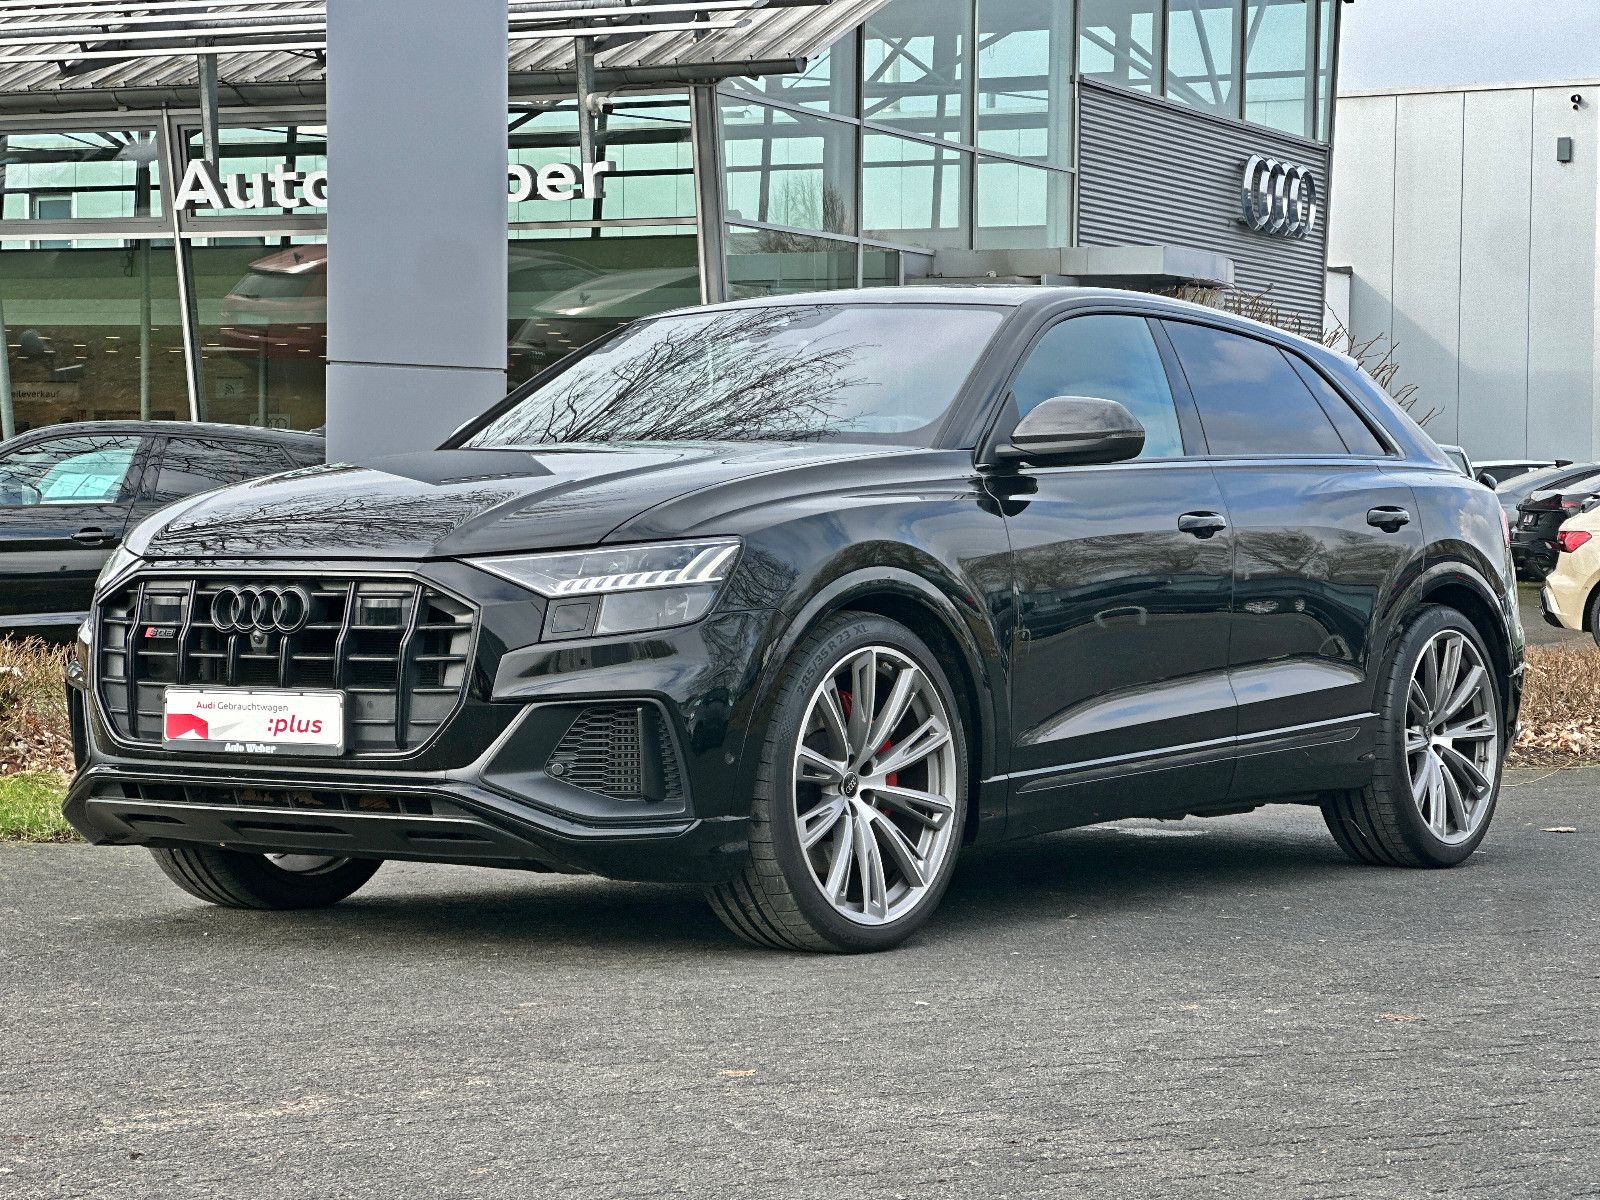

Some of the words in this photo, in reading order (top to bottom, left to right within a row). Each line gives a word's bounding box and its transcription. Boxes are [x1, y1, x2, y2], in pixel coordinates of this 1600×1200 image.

[173, 158, 327, 210] Auto
[827, 640, 838, 652] R
[836, 629, 851, 644] 23
[196, 701, 216, 710] Audi
[217, 701, 289, 713] Gebrauchtwagen
[224, 743, 244, 752] Auto
[246, 743, 277, 754] Weber
